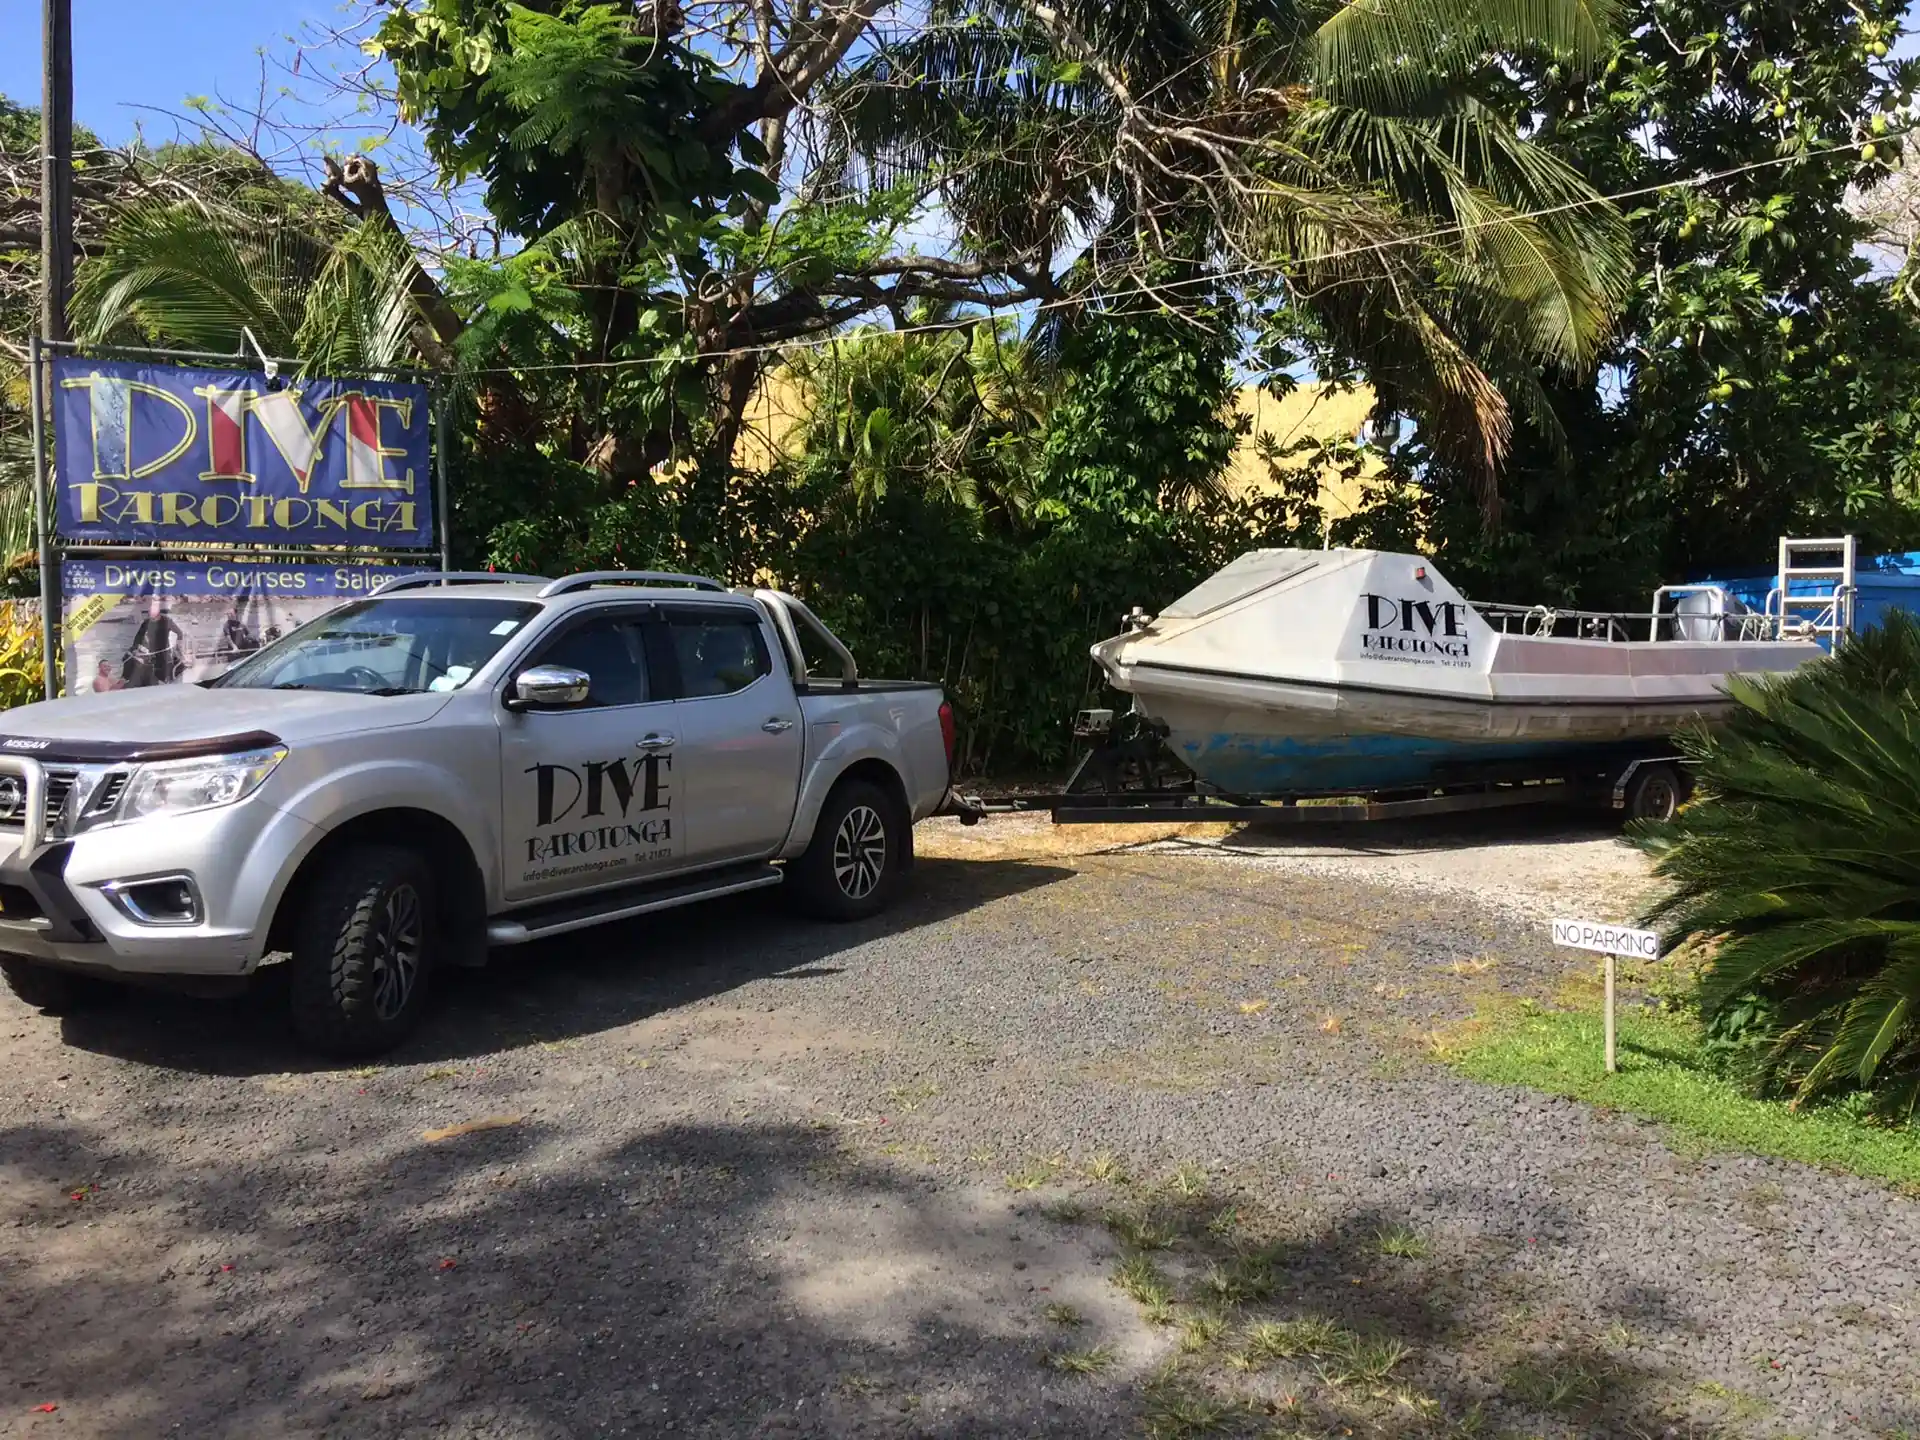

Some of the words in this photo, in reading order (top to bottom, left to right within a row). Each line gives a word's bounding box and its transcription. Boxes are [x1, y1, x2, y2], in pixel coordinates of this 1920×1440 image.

[60, 372, 416, 495] DIVE
[69, 482, 419, 532] RAROTONGA
[105, 565, 176, 588] Dives
[206, 566, 307, 589] Courses
[1360, 592, 1468, 638] DIVE
[1361, 634, 1469, 658] RAROTONGA
[2, 739, 51, 749] NISSAN
[524, 753, 672, 827] DIVE
[525, 818, 672, 864] RAROTONGA
[1554, 924, 1581, 944] NO
[1583, 927, 1658, 955] PARKING
